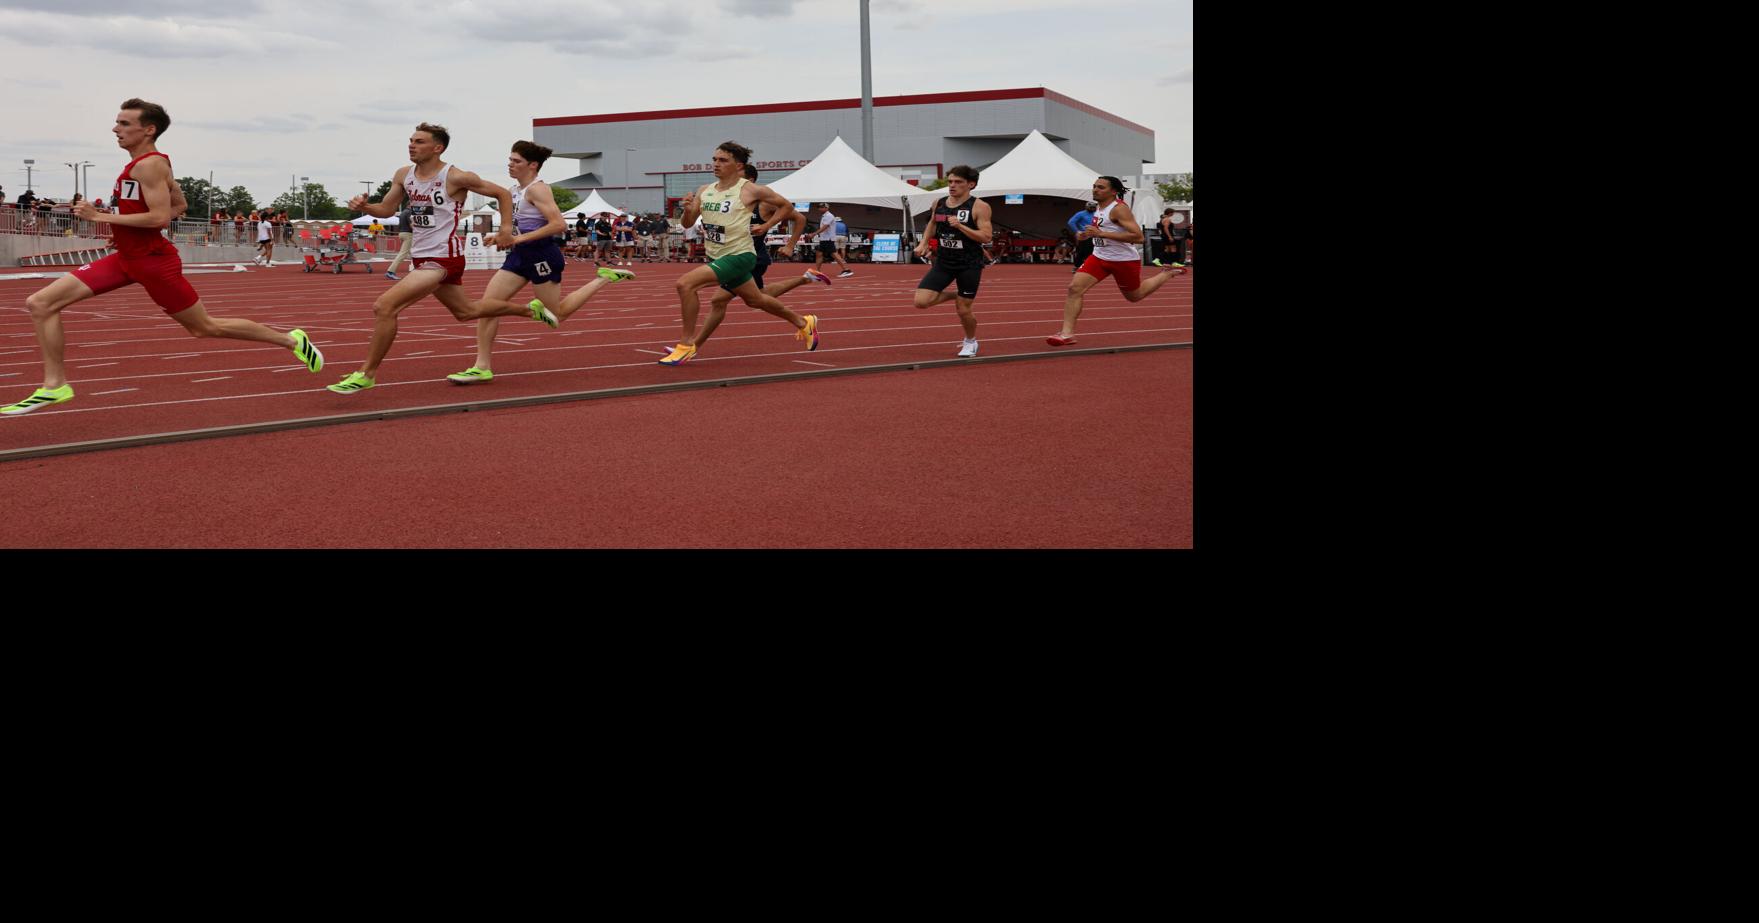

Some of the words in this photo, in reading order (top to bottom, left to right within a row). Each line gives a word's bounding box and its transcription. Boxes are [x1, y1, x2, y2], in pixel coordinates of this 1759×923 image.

[756, 160, 795, 169] SPORTS
[124, 181, 136, 199] 7
[433, 190, 444, 206] 6
[721, 200, 731, 213] 3
[959, 210, 967, 222] 9
[470, 236, 479, 247] 8
[539, 262, 549, 274] 4
